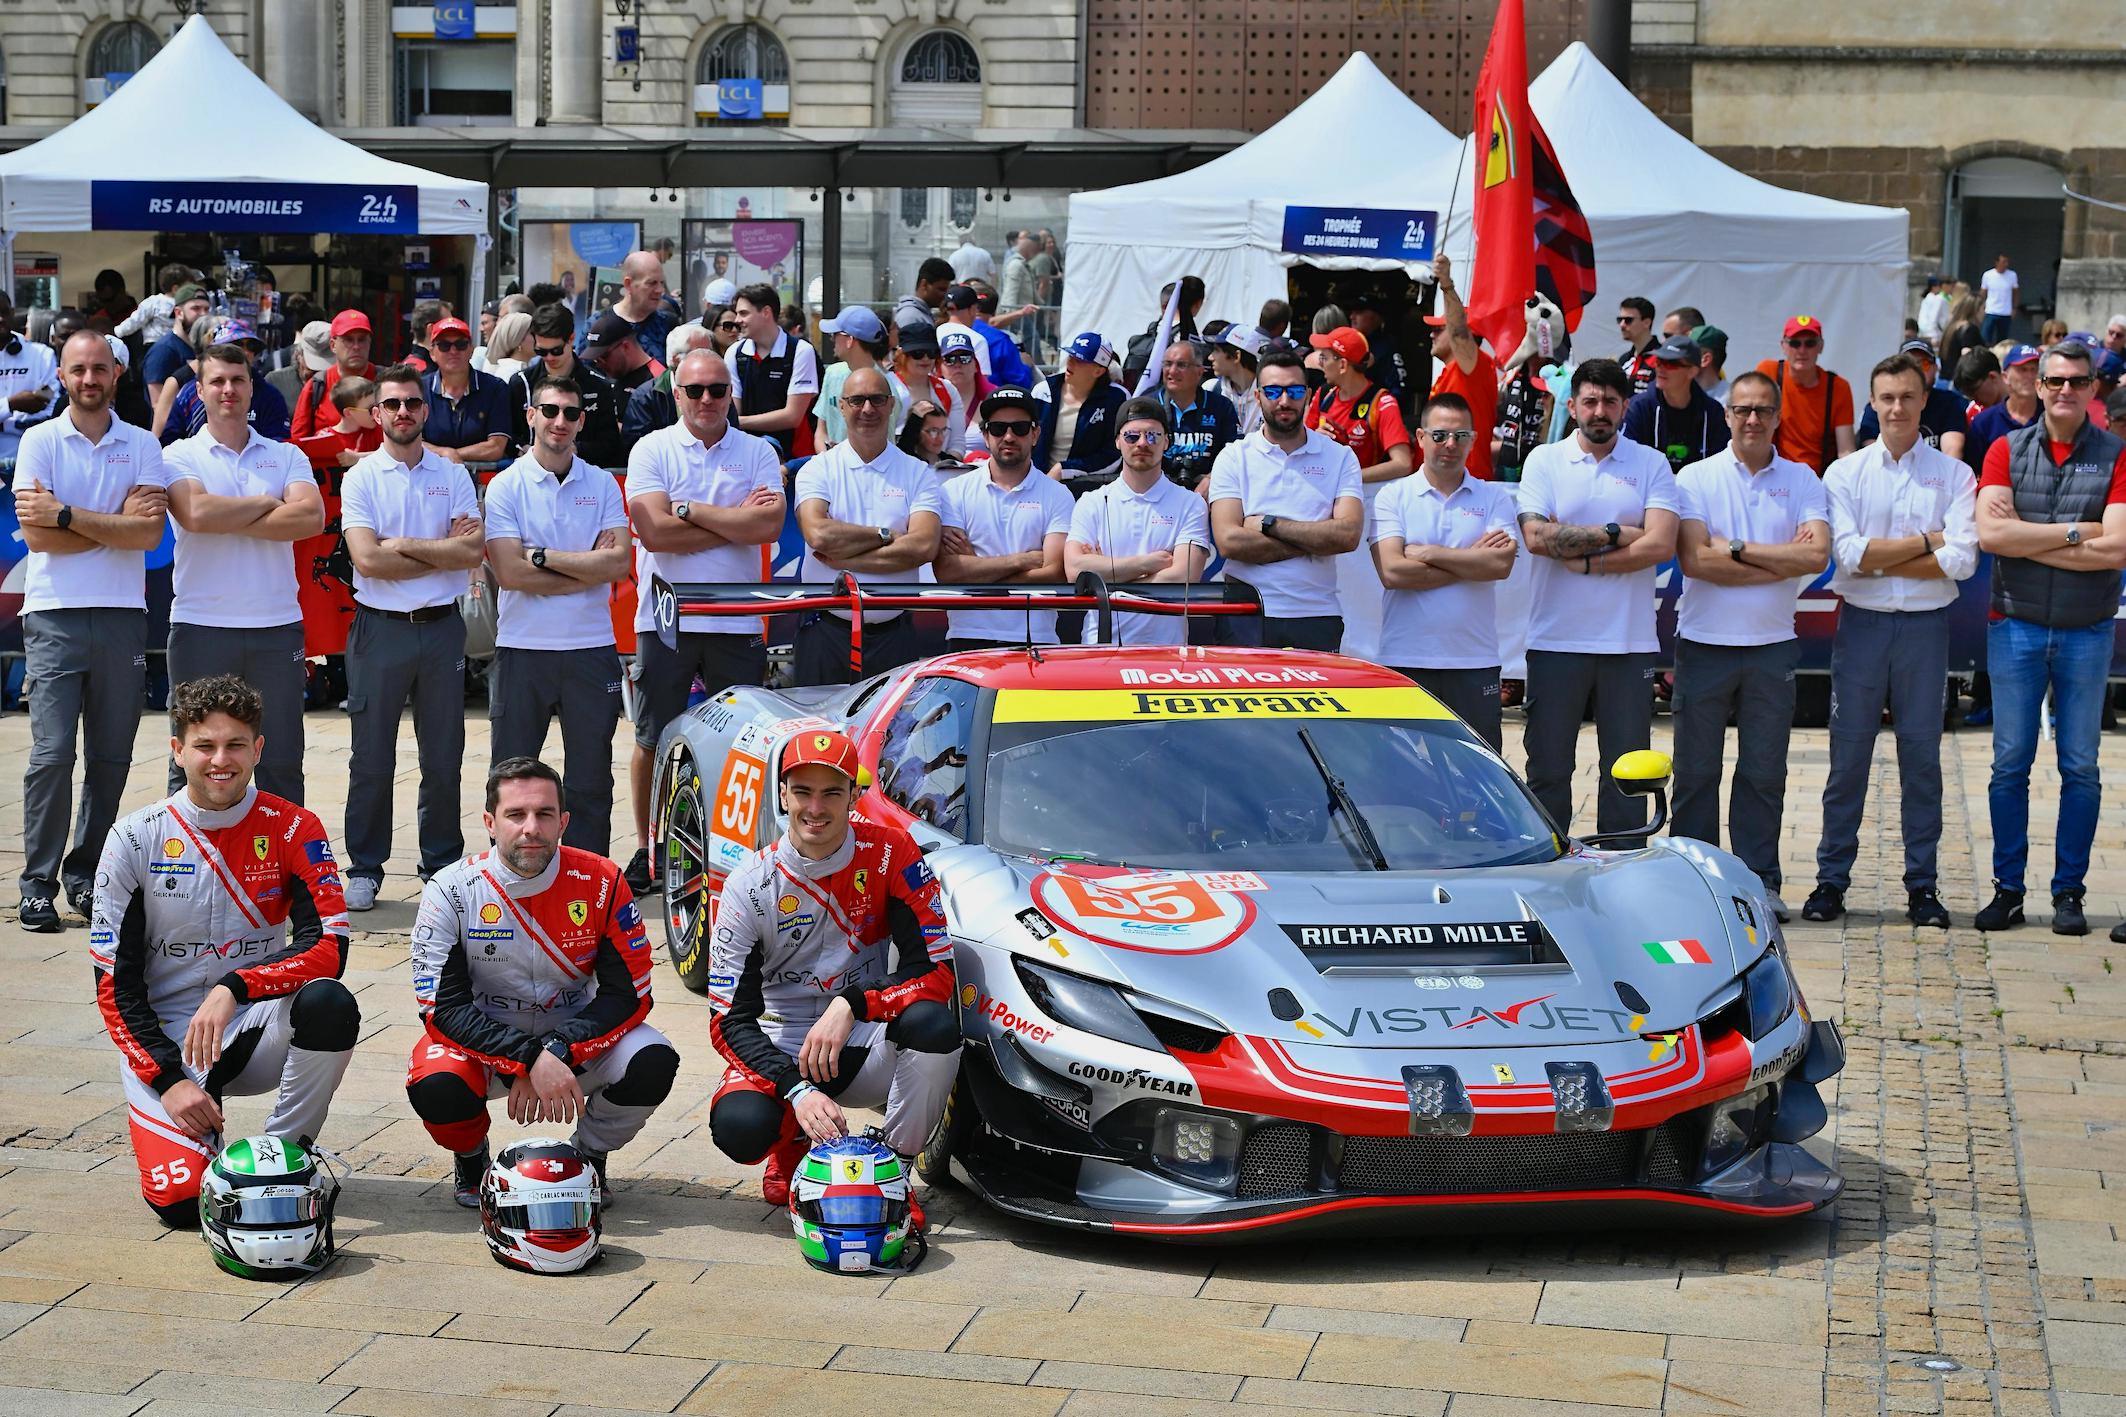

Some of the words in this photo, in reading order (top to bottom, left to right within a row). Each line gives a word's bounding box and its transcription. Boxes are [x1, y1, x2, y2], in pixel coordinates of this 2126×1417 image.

[434, 7, 469, 22] LCL
[719, 86, 758, 101] LCL
[149, 198, 172, 213] RS
[175, 198, 303, 215] AUTOMOBILES
[371, 216, 396, 224] MANS
[1323, 215, 1364, 234] TROPHÉE
[1303, 234, 1316, 247] DES
[1359, 237, 1380, 250] MANS
[1119, 667, 1220, 685] Mobil
[1221, 666, 1329, 684] Plastic
[1131, 691, 1351, 714] Ferrari
[721, 759, 761, 836] 55
[283, 814, 303, 843] Sabelt
[244, 862, 280, 871] VISTA
[878, 843, 893, 876] Sabelt
[1204, 873, 1246, 881] LM
[1207, 881, 1258, 890] GT3
[448, 884, 466, 914] Sabelt
[596, 876, 610, 910] Sabelt
[1082, 880, 1196, 920] 55
[469, 929, 513, 939] GOODYEAR
[1121, 921, 1191, 932] WEC
[1300, 926, 1434, 946] RICHARD
[1442, 924, 1528, 944] MILLE
[977, 993, 1055, 1045] V-Power
[1046, 1097, 1089, 1124] OPOL
[150, 1157, 191, 1191] 55
[540, 1192, 560, 1200] CARLAC
[561, 1191, 584, 1199] MINERALS
[810, 1233, 821, 1242] BELL
